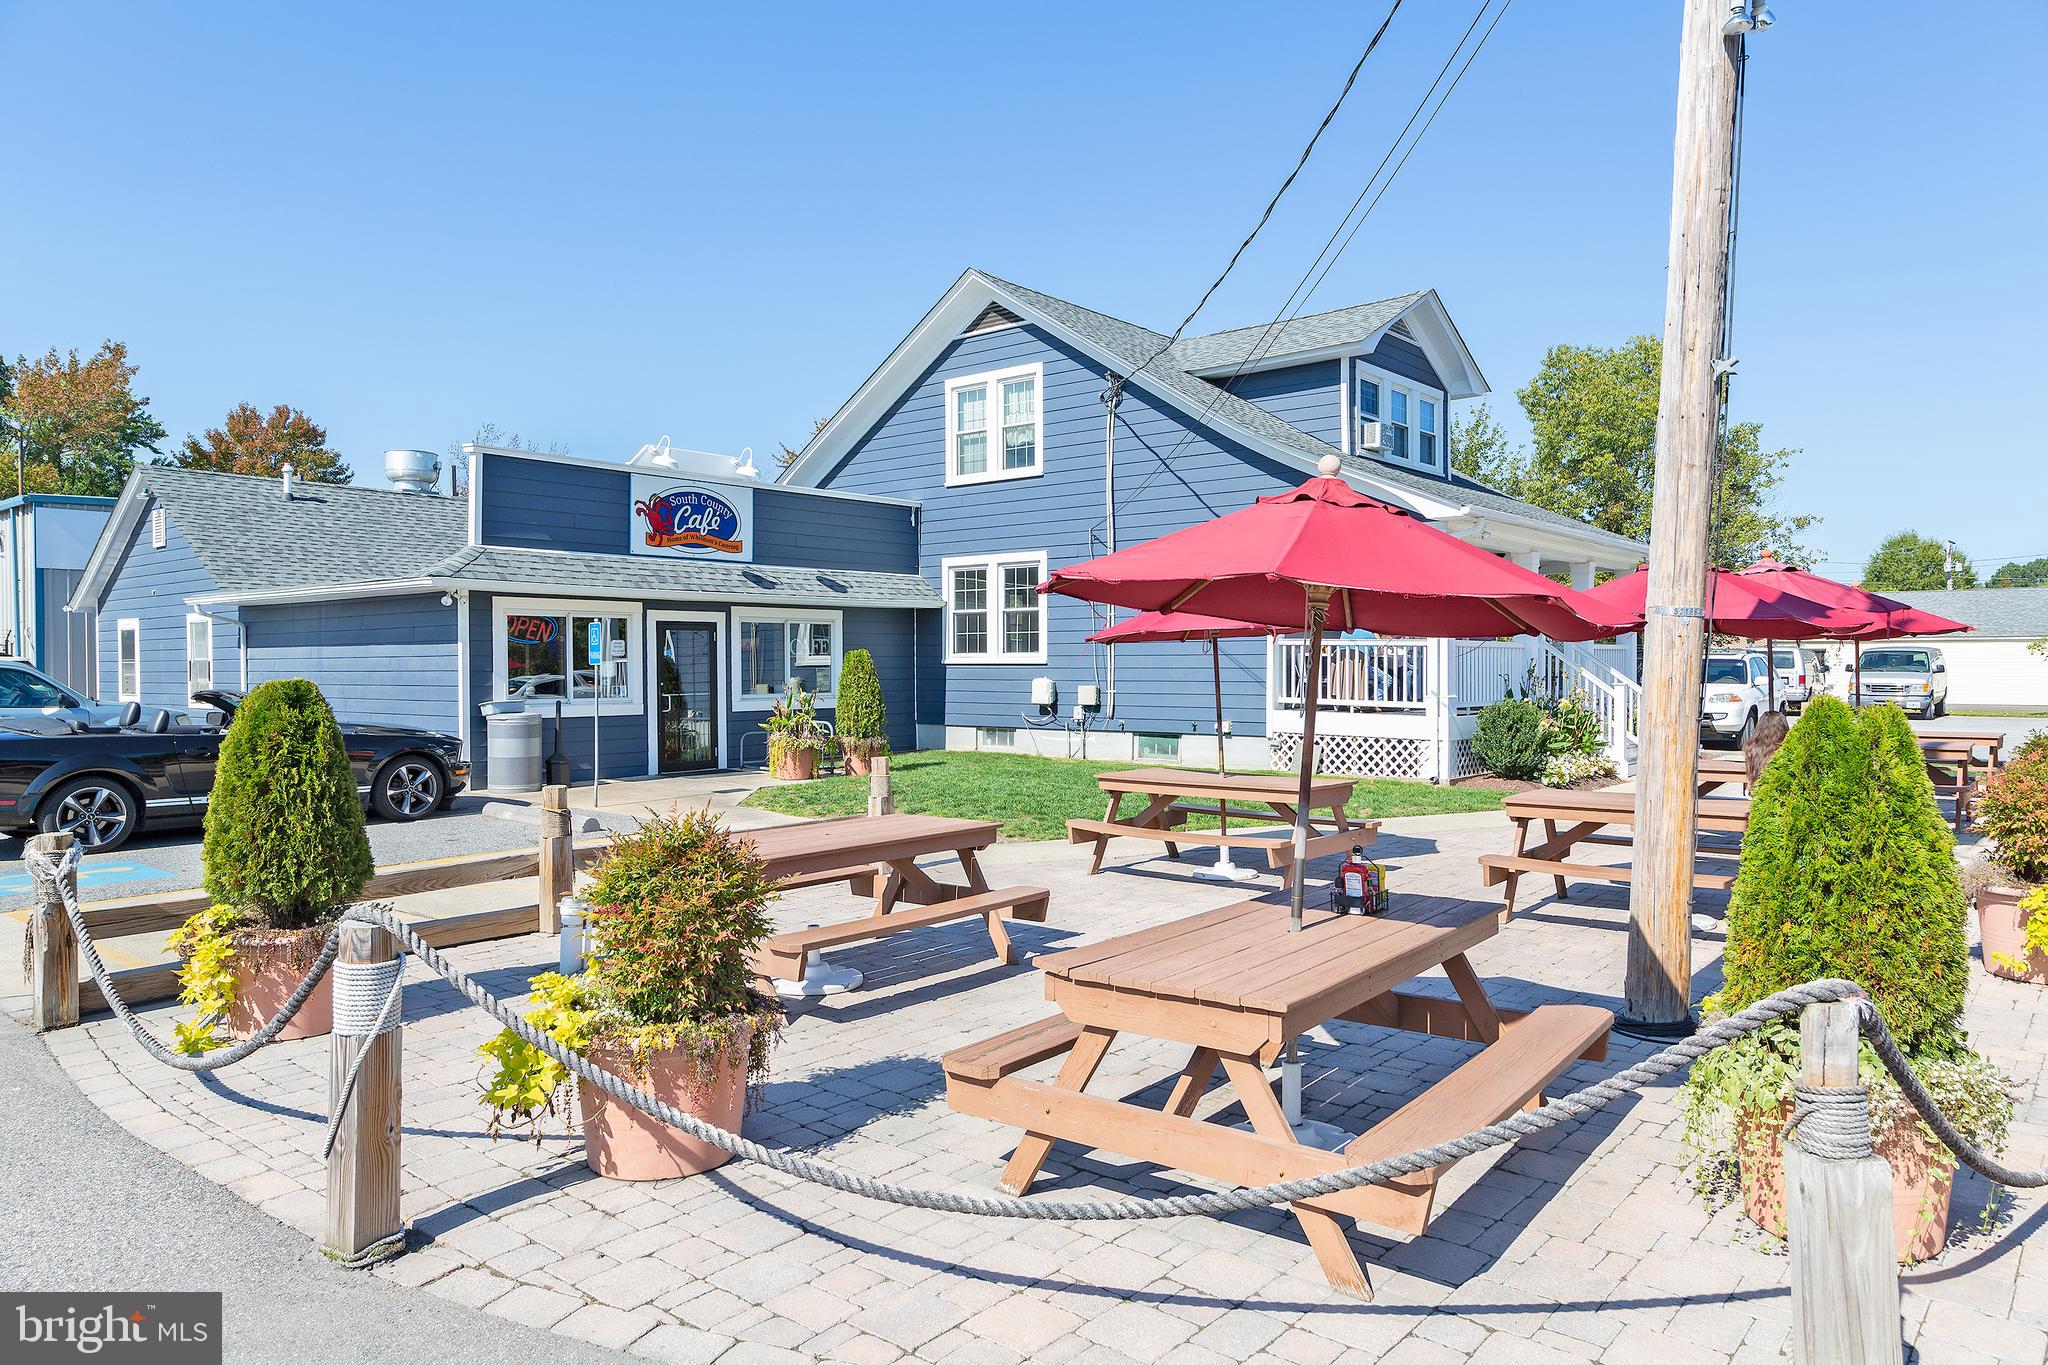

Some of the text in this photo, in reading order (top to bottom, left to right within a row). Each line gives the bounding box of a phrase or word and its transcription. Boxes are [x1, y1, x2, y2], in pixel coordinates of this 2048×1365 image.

[669, 494, 733, 519] South County
[674, 505, 721, 536] Café
[666, 534, 682, 543] Home
[683, 533, 689, 541] of
[718, 541, 739, 552] Catering
[507, 616, 552, 642] OPEN
